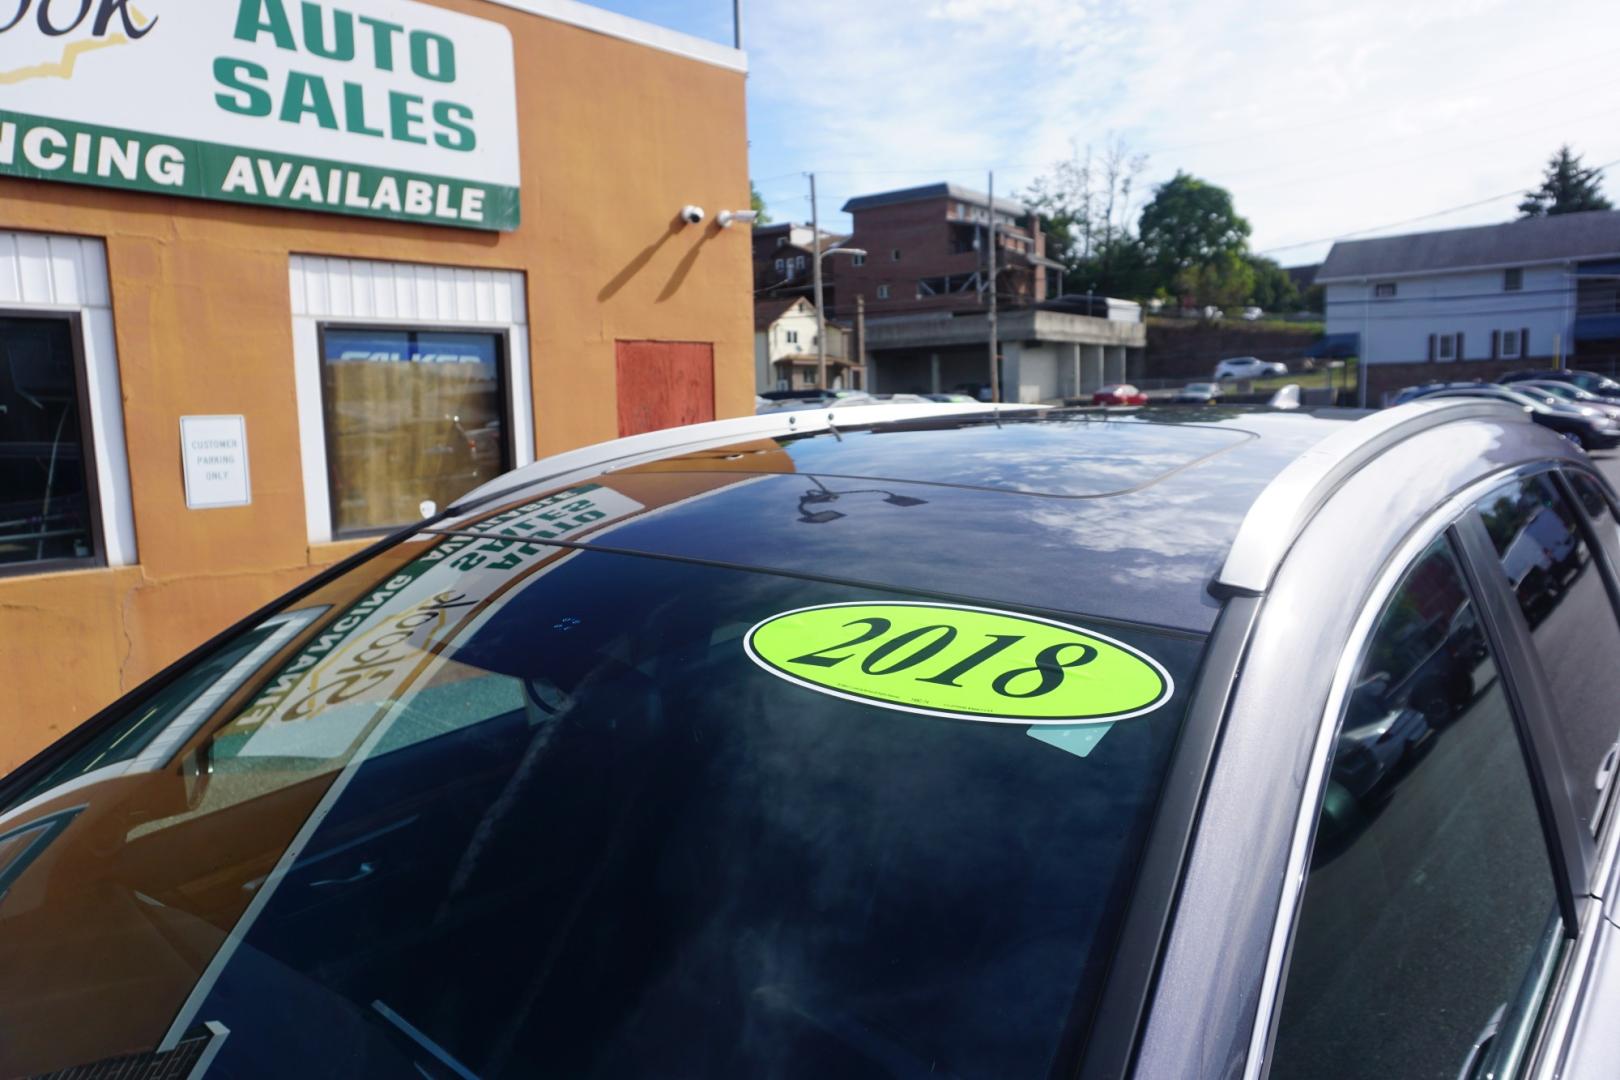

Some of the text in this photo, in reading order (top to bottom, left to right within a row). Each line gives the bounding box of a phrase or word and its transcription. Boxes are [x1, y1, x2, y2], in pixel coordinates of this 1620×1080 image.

[233, 0, 458, 83] AUTO
[213, 56, 477, 153] SALES
[222, 156, 485, 222] AVAILABLE
[191, 440, 237, 449] CUSTOMER
[197, 455, 235, 464] PARKING
[206, 471, 228, 481] ONLY
[787, 617, 1098, 698] 2018
